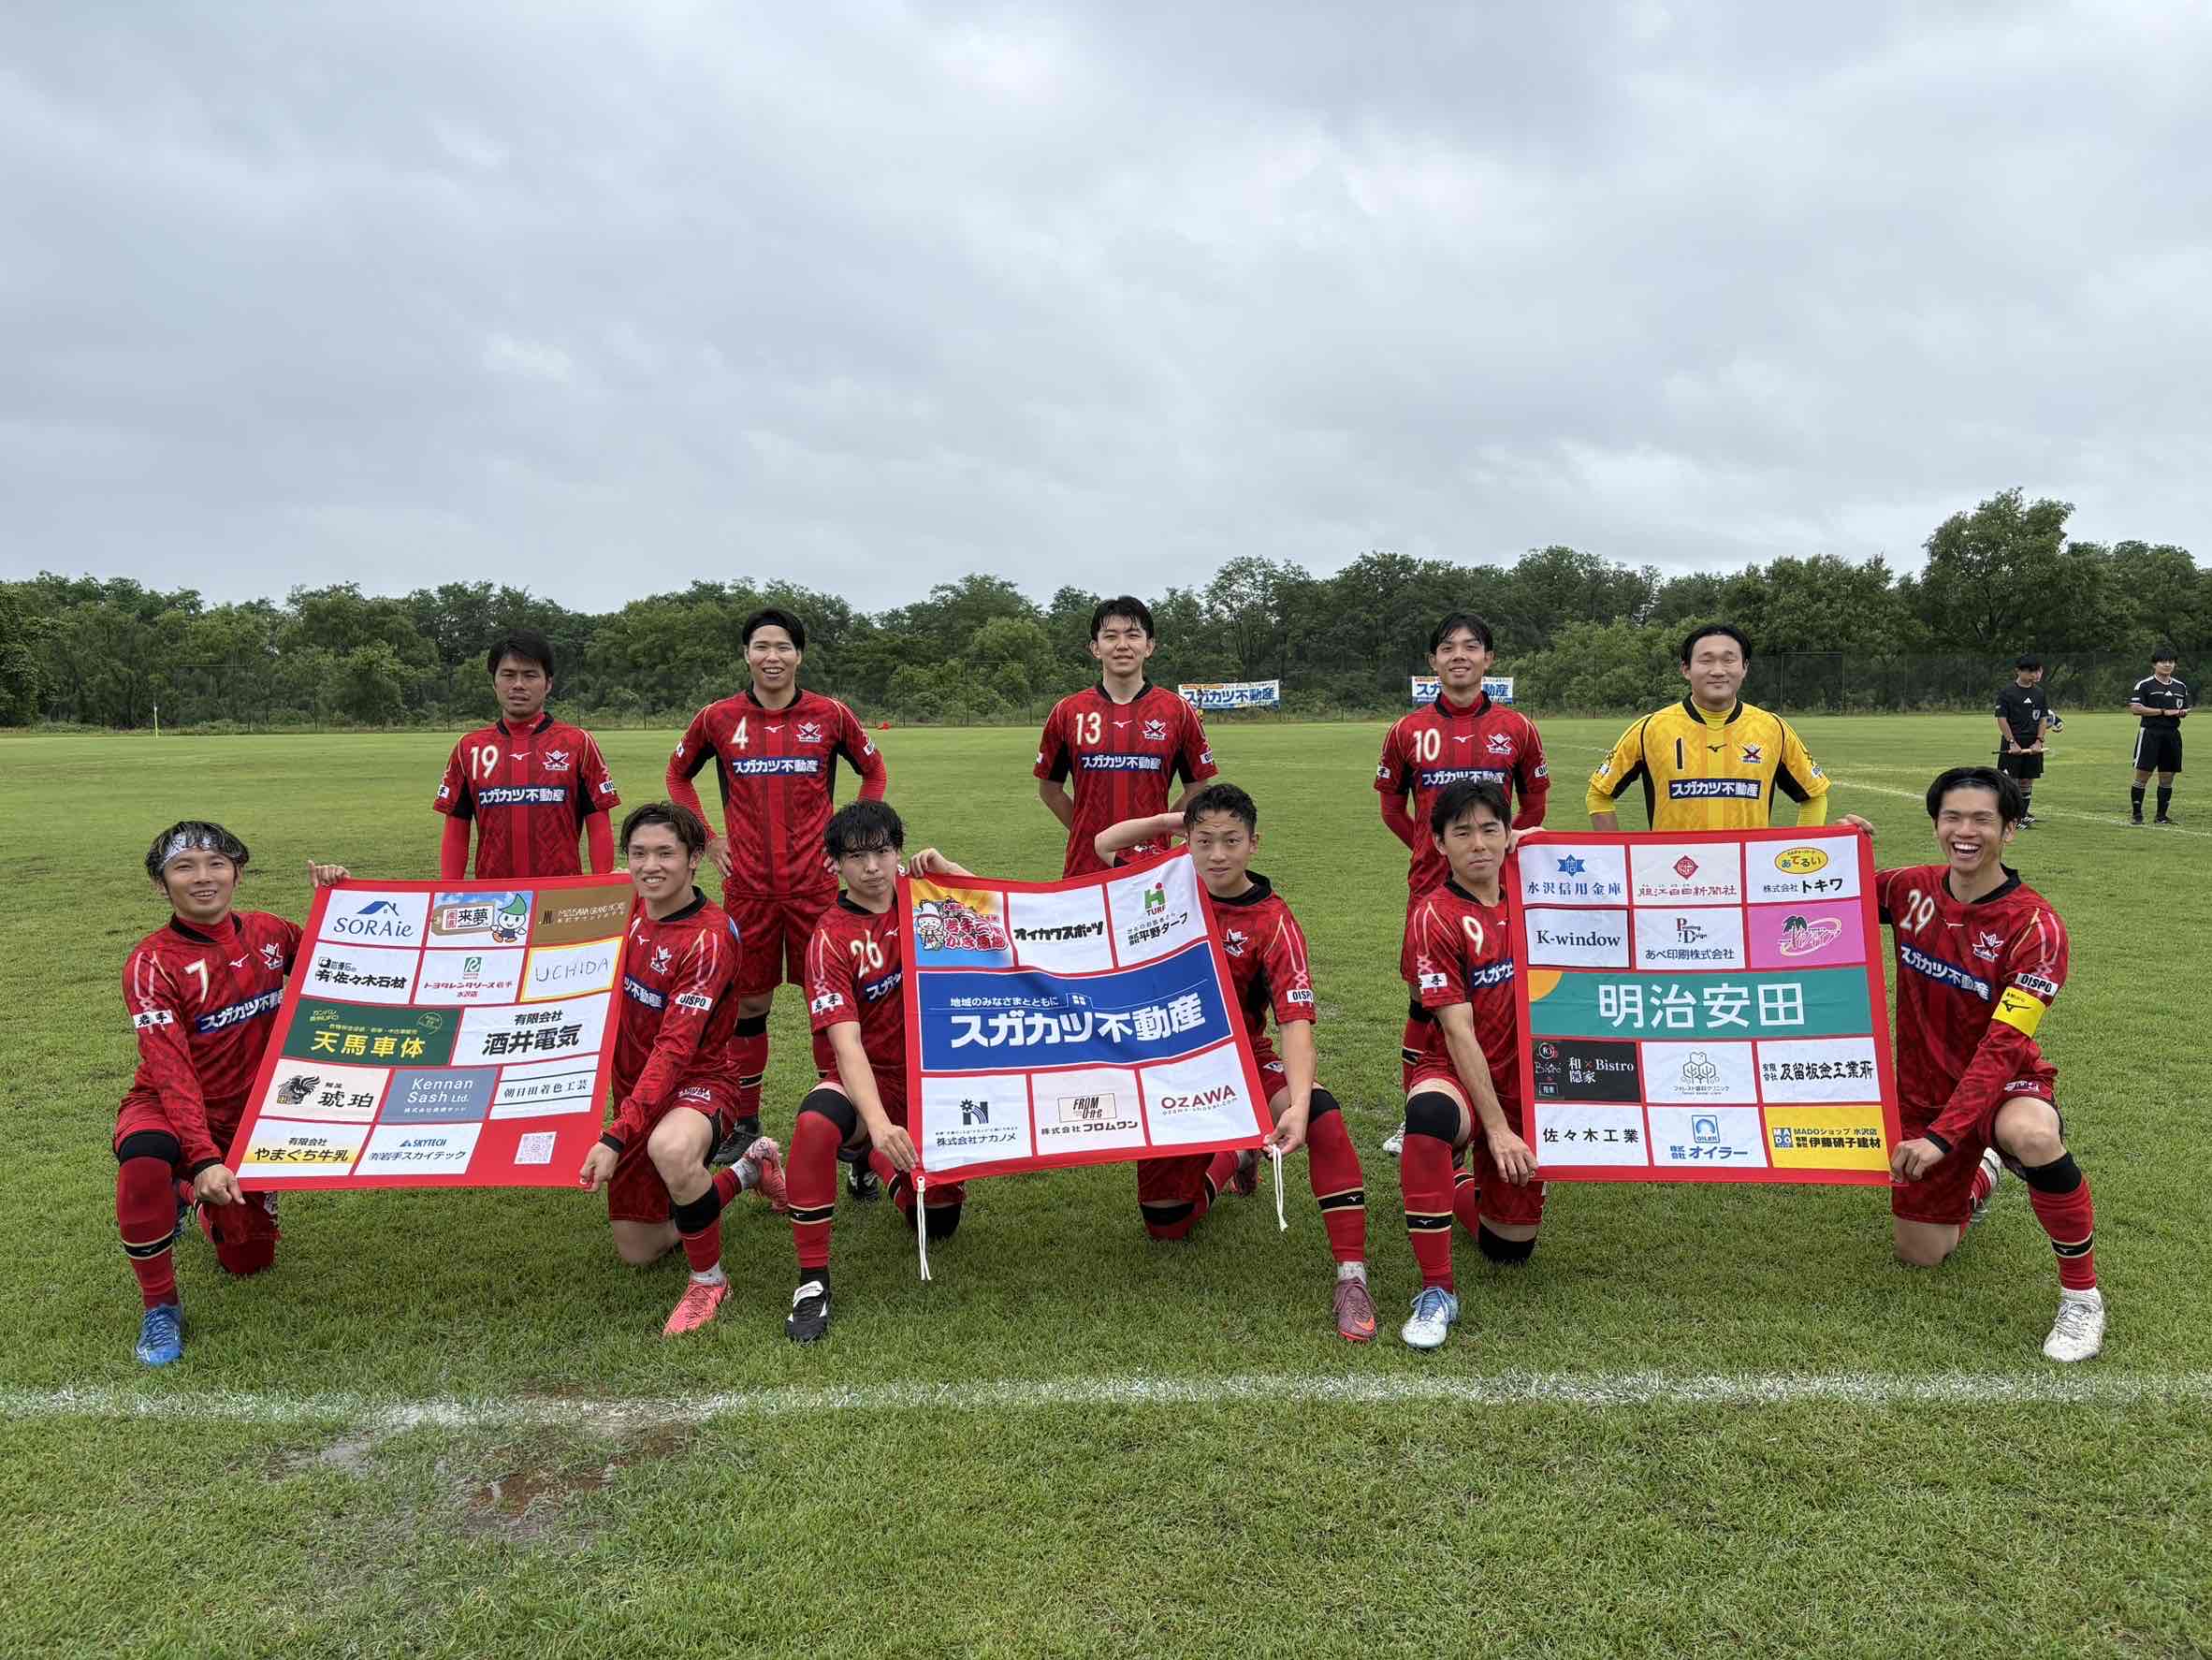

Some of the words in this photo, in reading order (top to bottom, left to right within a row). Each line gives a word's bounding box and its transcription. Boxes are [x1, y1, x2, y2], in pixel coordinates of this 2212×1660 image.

[731, 716, 749, 750] 4
[1076, 712, 1102, 746] 13
[1414, 728, 1441, 763] 10
[1676, 736, 1684, 771] 1
[470, 745, 499, 779] 19
[733, 759, 819, 774] スガカツ不動産
[1082, 754, 1161, 770] スガカツ不動産
[479, 788, 565, 805] スガカツ不動産
[1671, 781, 1759, 796] スガカツ不動産
[1782, 855, 1821, 868] あてるい
[1527, 881, 1622, 896] 水沢信用金庫
[1899, 889, 1935, 938] 29
[333, 917, 414, 937] SORAie
[1463, 916, 1483, 957] 9
[1537, 930, 1621, 947] K-window
[1645, 949, 1735, 960] あべ印刷株式会社
[535, 958, 608, 982] UCHIDA
[1900, 945, 1991, 1000] スガカツ不動産
[184, 958, 209, 1003] 7
[201, 989, 284, 1030] スガカツ不動
[950, 997, 1058, 1007] 地域のみなさまとともに
[1598, 983, 1805, 1028] 明治安田
[515, 1010, 563, 1026] 有限会社
[951, 992, 1206, 1048] スガカツ不動産
[310, 1030, 426, 1058] 天馬車体
[482, 1024, 582, 1056] 酒井電気
[1595, 1058, 1634, 1071] Bistro
[412, 1078, 473, 1090] Kennan
[318, 1091, 374, 1108] 琥珀
[407, 1091, 448, 1103] Sash
[1072, 1097, 1099, 1111] FROM
[1161, 1085, 1236, 1109] OZAWA
[287, 1138, 327, 1146] 有限会社
[413, 1139, 447, 1147] SKYTECH
[937, 1133, 1017, 1146] 株式会社ナカノメ
[1543, 1128, 1639, 1143] 佐々木工業
[255, 1148, 349, 1162] やまぐち牛乳
[1689, 1145, 1748, 1159] オイラー
